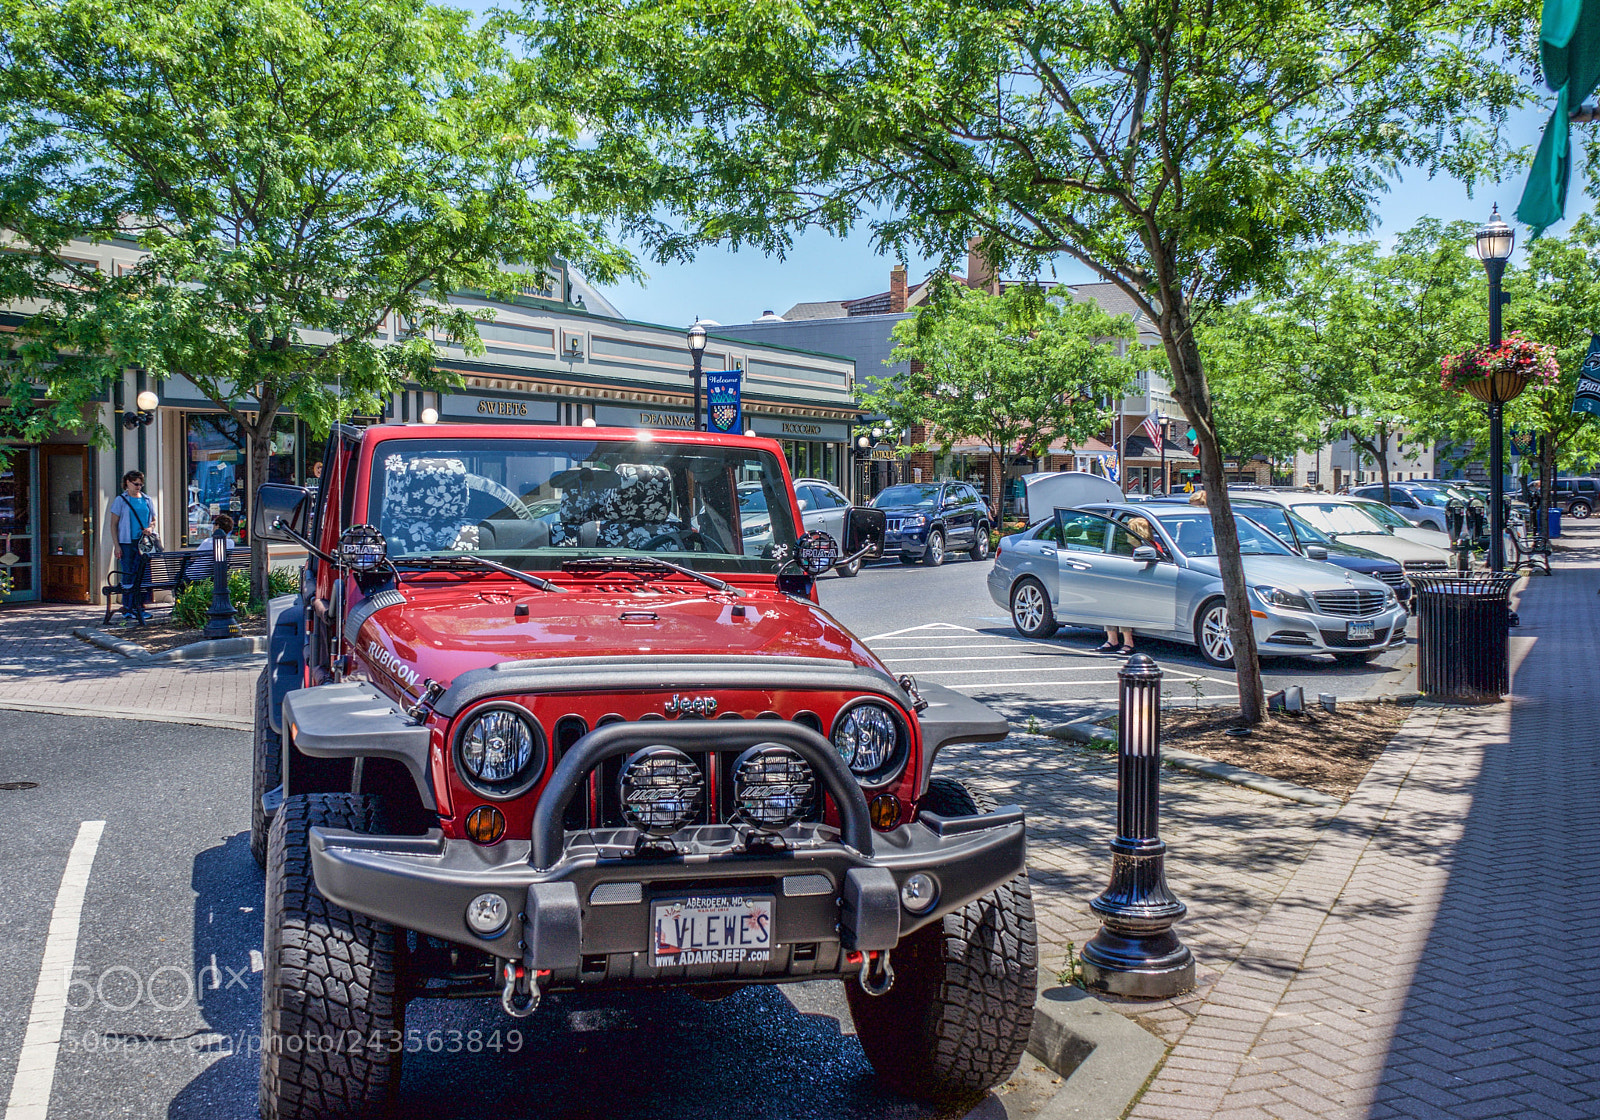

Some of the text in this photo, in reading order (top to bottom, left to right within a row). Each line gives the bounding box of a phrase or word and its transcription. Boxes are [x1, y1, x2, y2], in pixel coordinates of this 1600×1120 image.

[708, 375, 739, 384] Welcome
[477, 400, 529, 416] SWEETS
[802, 548, 837, 558] PIAA
[367, 640, 420, 686] RUBICON
[664, 693, 718, 715] Jeep
[686, 896, 730, 908] ABERDEEN,
[656, 913, 770, 950] LVLEWES
